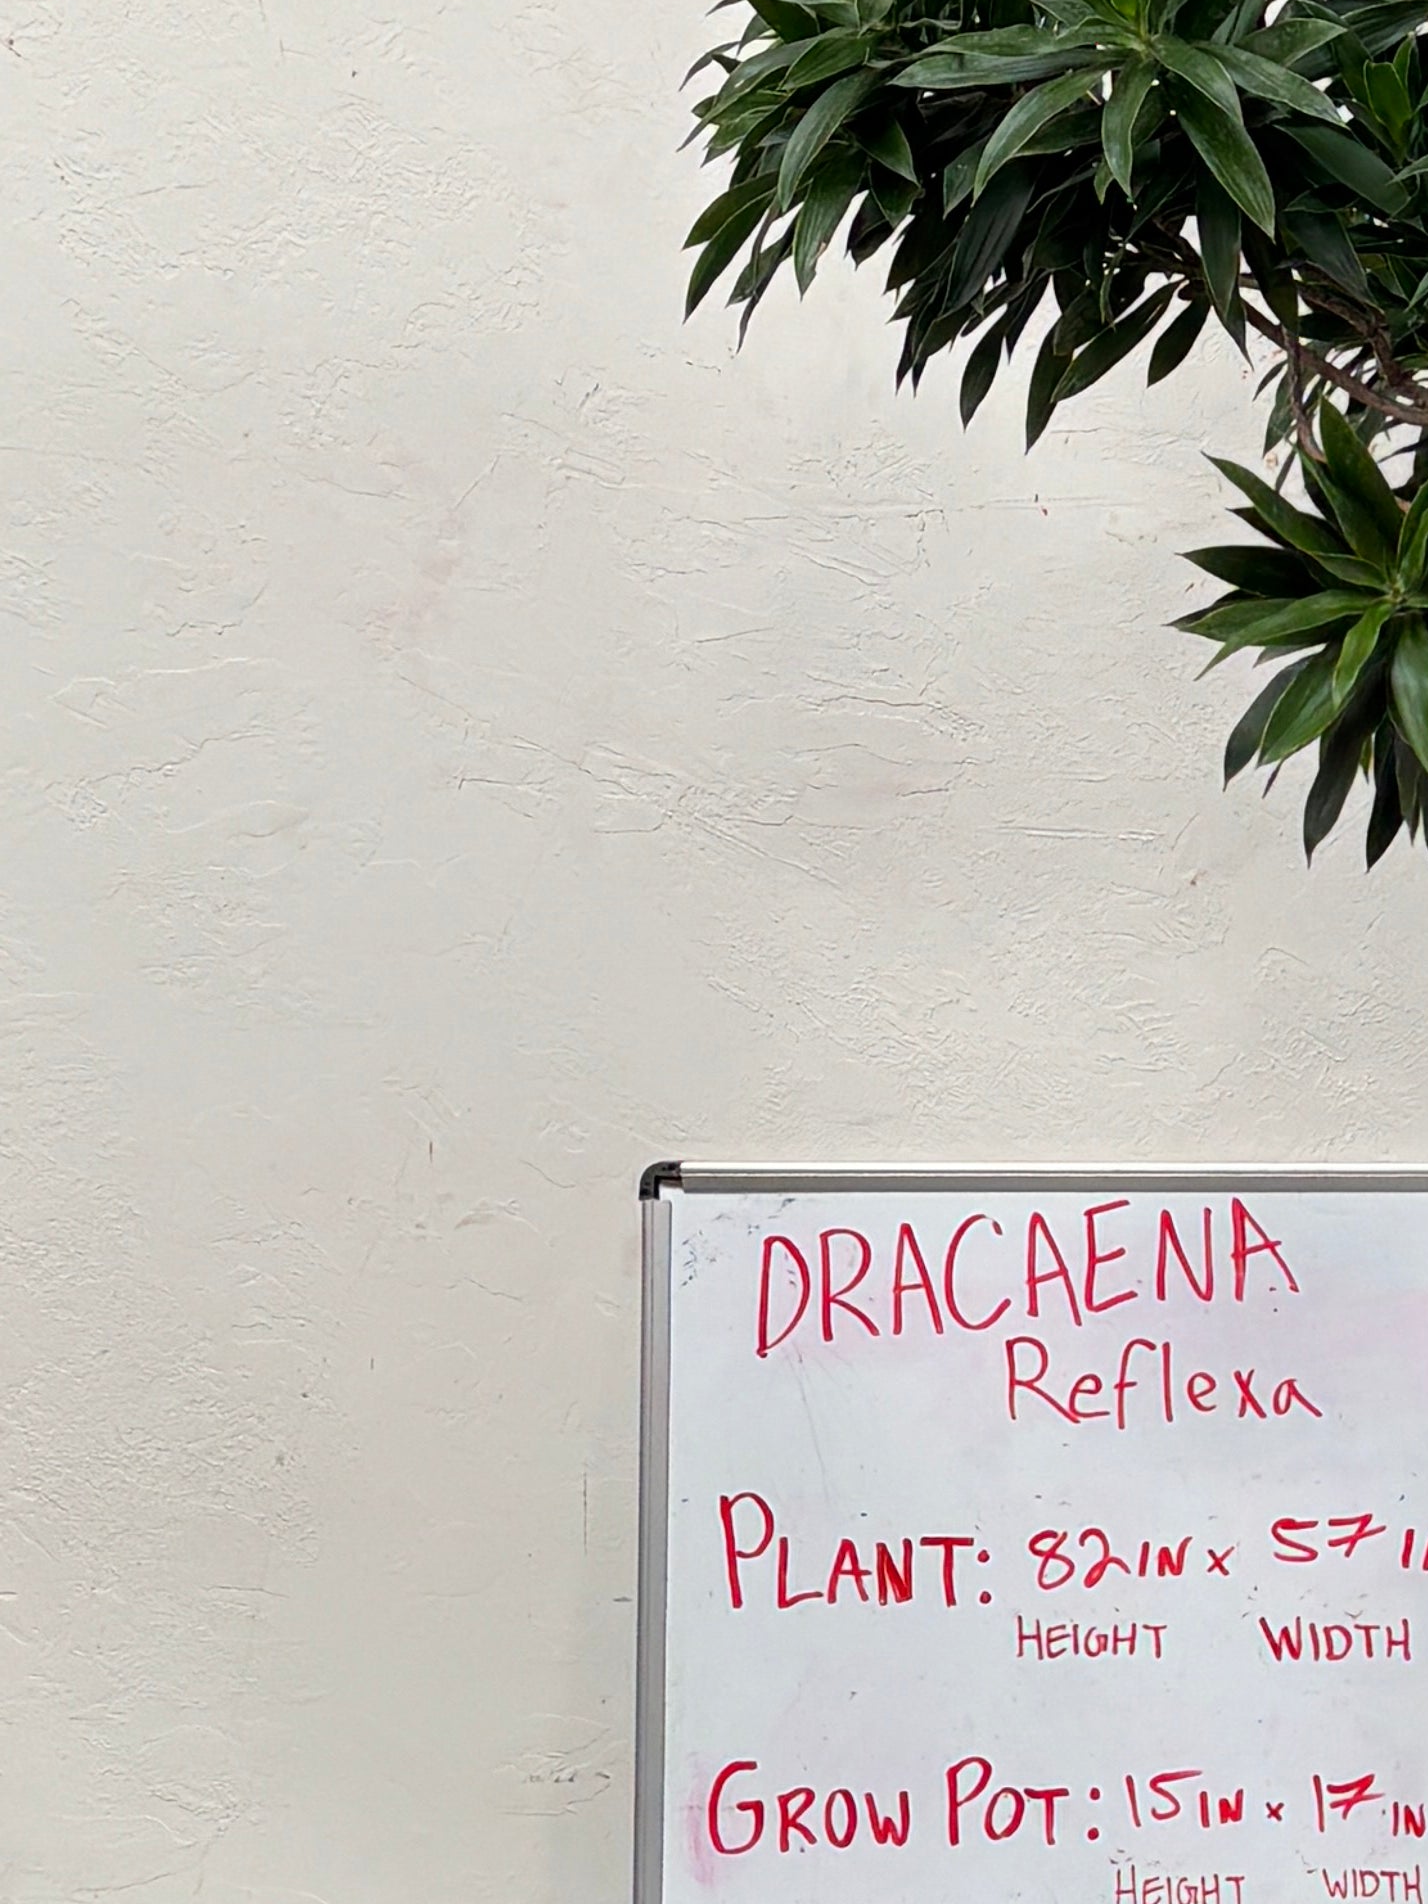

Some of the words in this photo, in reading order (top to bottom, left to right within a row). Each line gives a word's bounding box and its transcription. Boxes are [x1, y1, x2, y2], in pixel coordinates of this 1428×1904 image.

[756, 1198, 1300, 1358] DRACAENA
[1005, 1336, 1323, 1429] Reflexa
[719, 1492, 992, 1610] PLANT:
[1016, 1616, 1168, 1659] HEIGHT
[1259, 1617, 1412, 1662] WIDTH
[708, 1760, 910, 1854] GROW
[945, 1756, 1101, 1848] POT:
